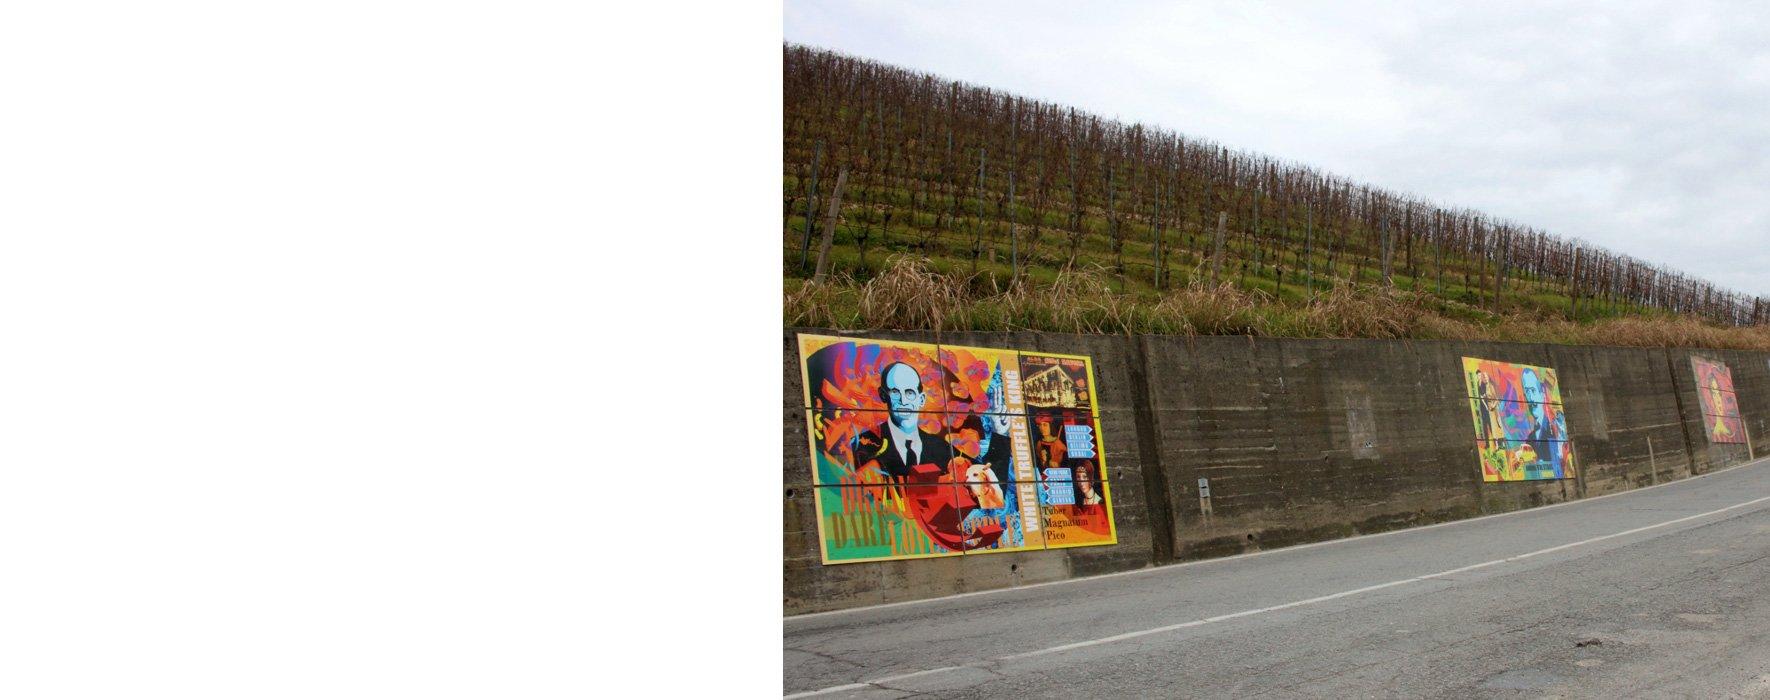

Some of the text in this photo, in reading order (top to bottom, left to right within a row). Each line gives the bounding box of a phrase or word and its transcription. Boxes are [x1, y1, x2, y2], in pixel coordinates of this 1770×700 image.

[1005, 370, 1039, 532] WHITE TRUFFLE'S KING
[1042, 506, 1065, 515] Tuber
[1045, 518, 1088, 529] Magnatum
[1047, 530, 1066, 540] Pico
